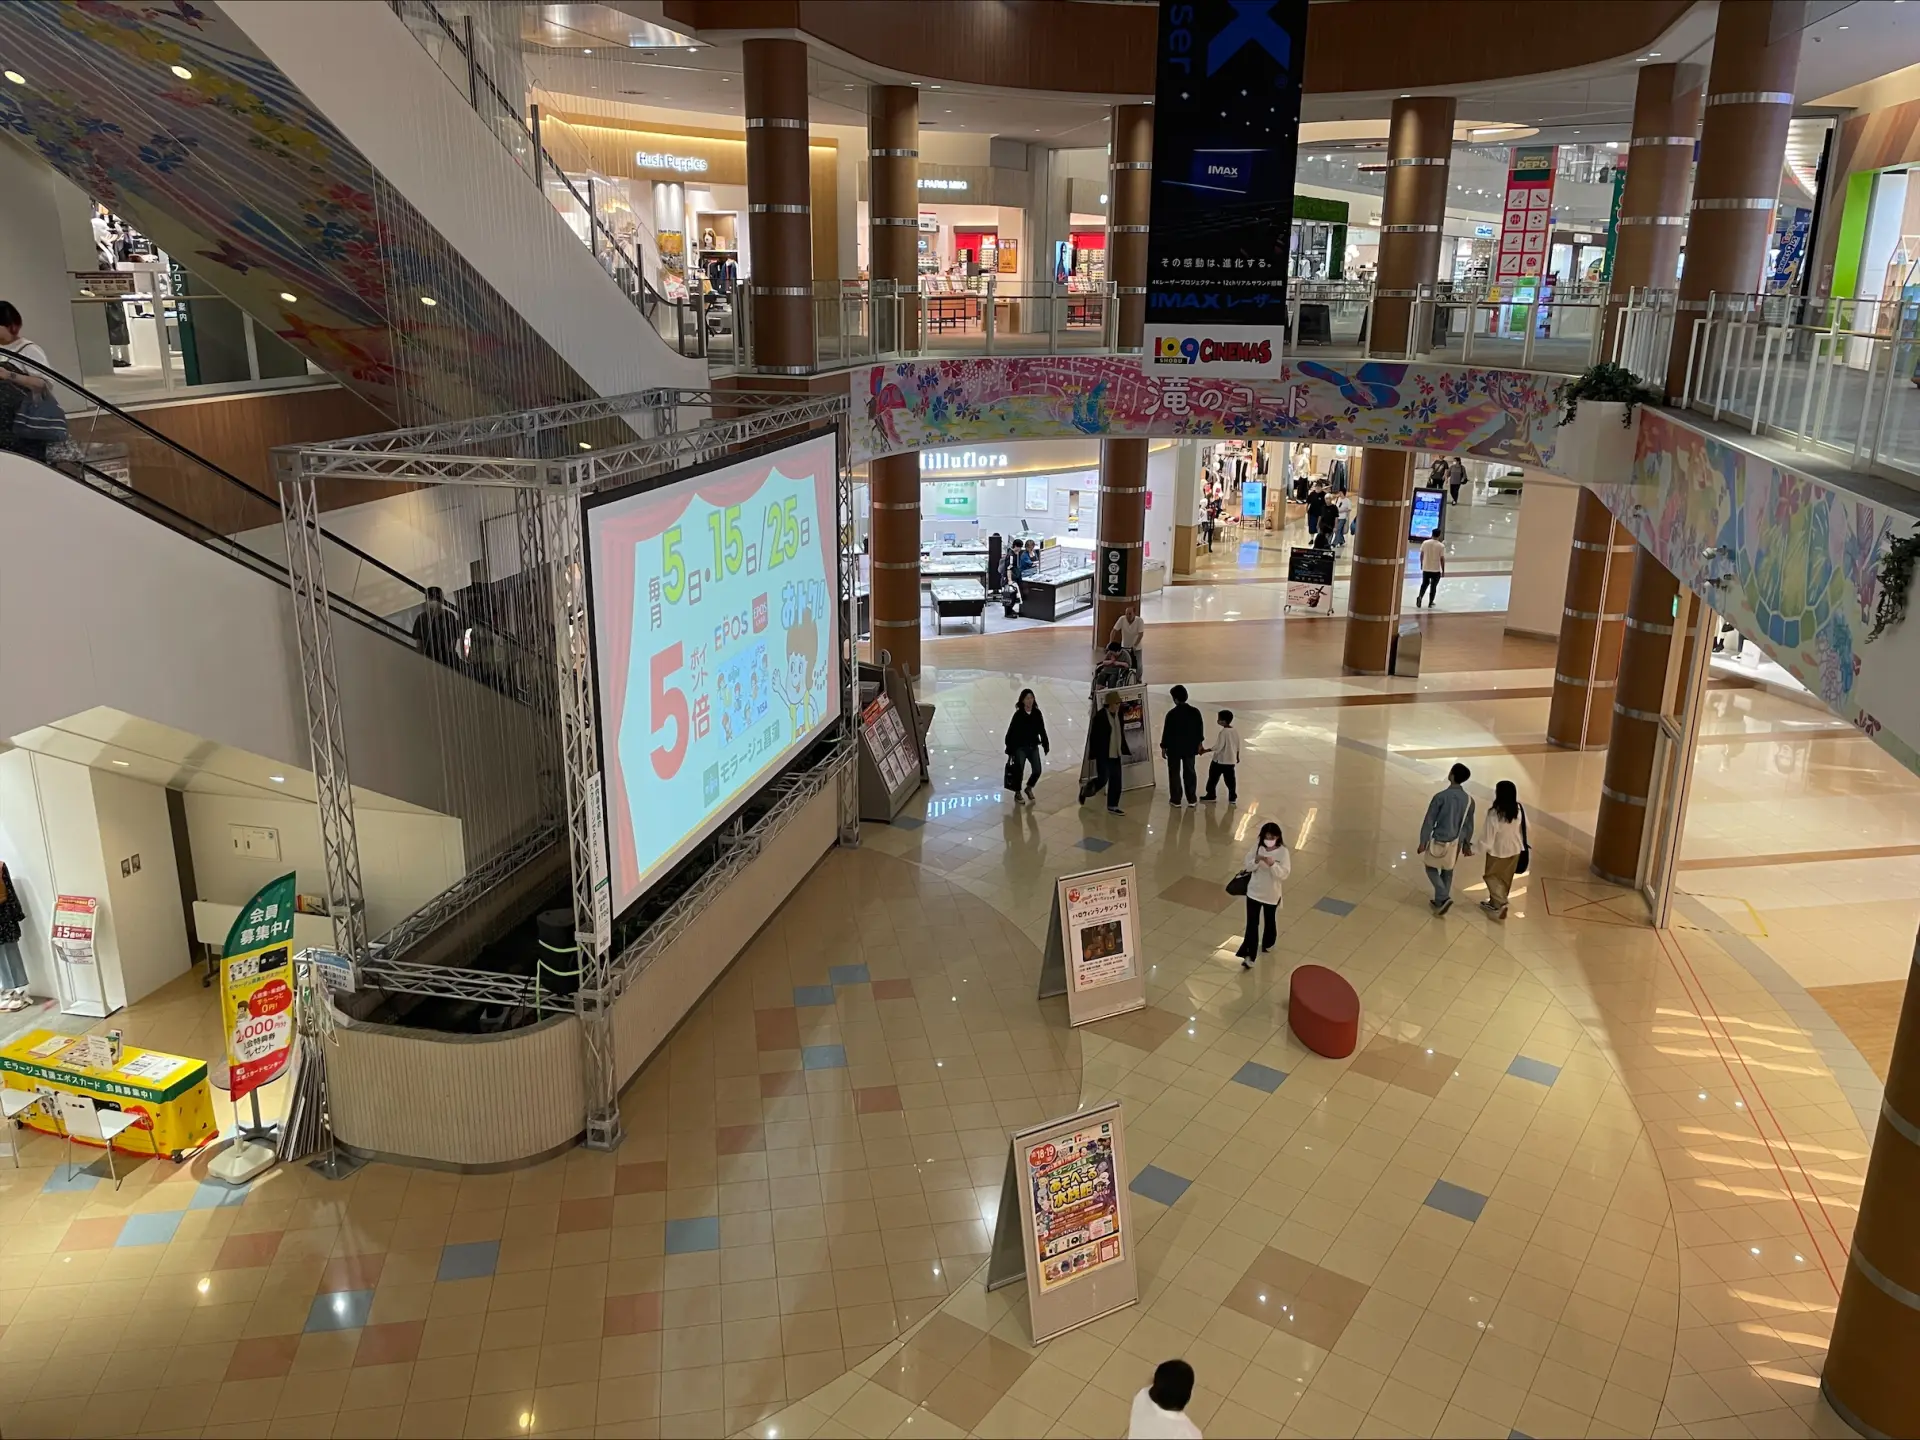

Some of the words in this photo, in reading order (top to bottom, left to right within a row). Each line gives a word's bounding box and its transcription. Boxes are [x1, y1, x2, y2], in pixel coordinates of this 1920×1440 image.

[1207, 165, 1238, 175] IMAX
[1517, 160, 1549, 169] DEPO
[924, 180, 948, 190] PARIS
[948, 180, 968, 190] MIKI
[1160, 257, 1272, 269] その感動は、進化する。
[172, 264, 188, 322] フロア案内
[1150, 291, 1220, 309] IMAX
[1226, 293, 1281, 309] レーザー
[1154, 336, 1200, 365] 109
[1199, 338, 1272, 364] CINEMAS
[650, 640, 690, 781] 5
[691, 693, 711, 743] 倍
[250, 903, 279, 924] 会員
[240, 918, 290, 946] 募集中!
